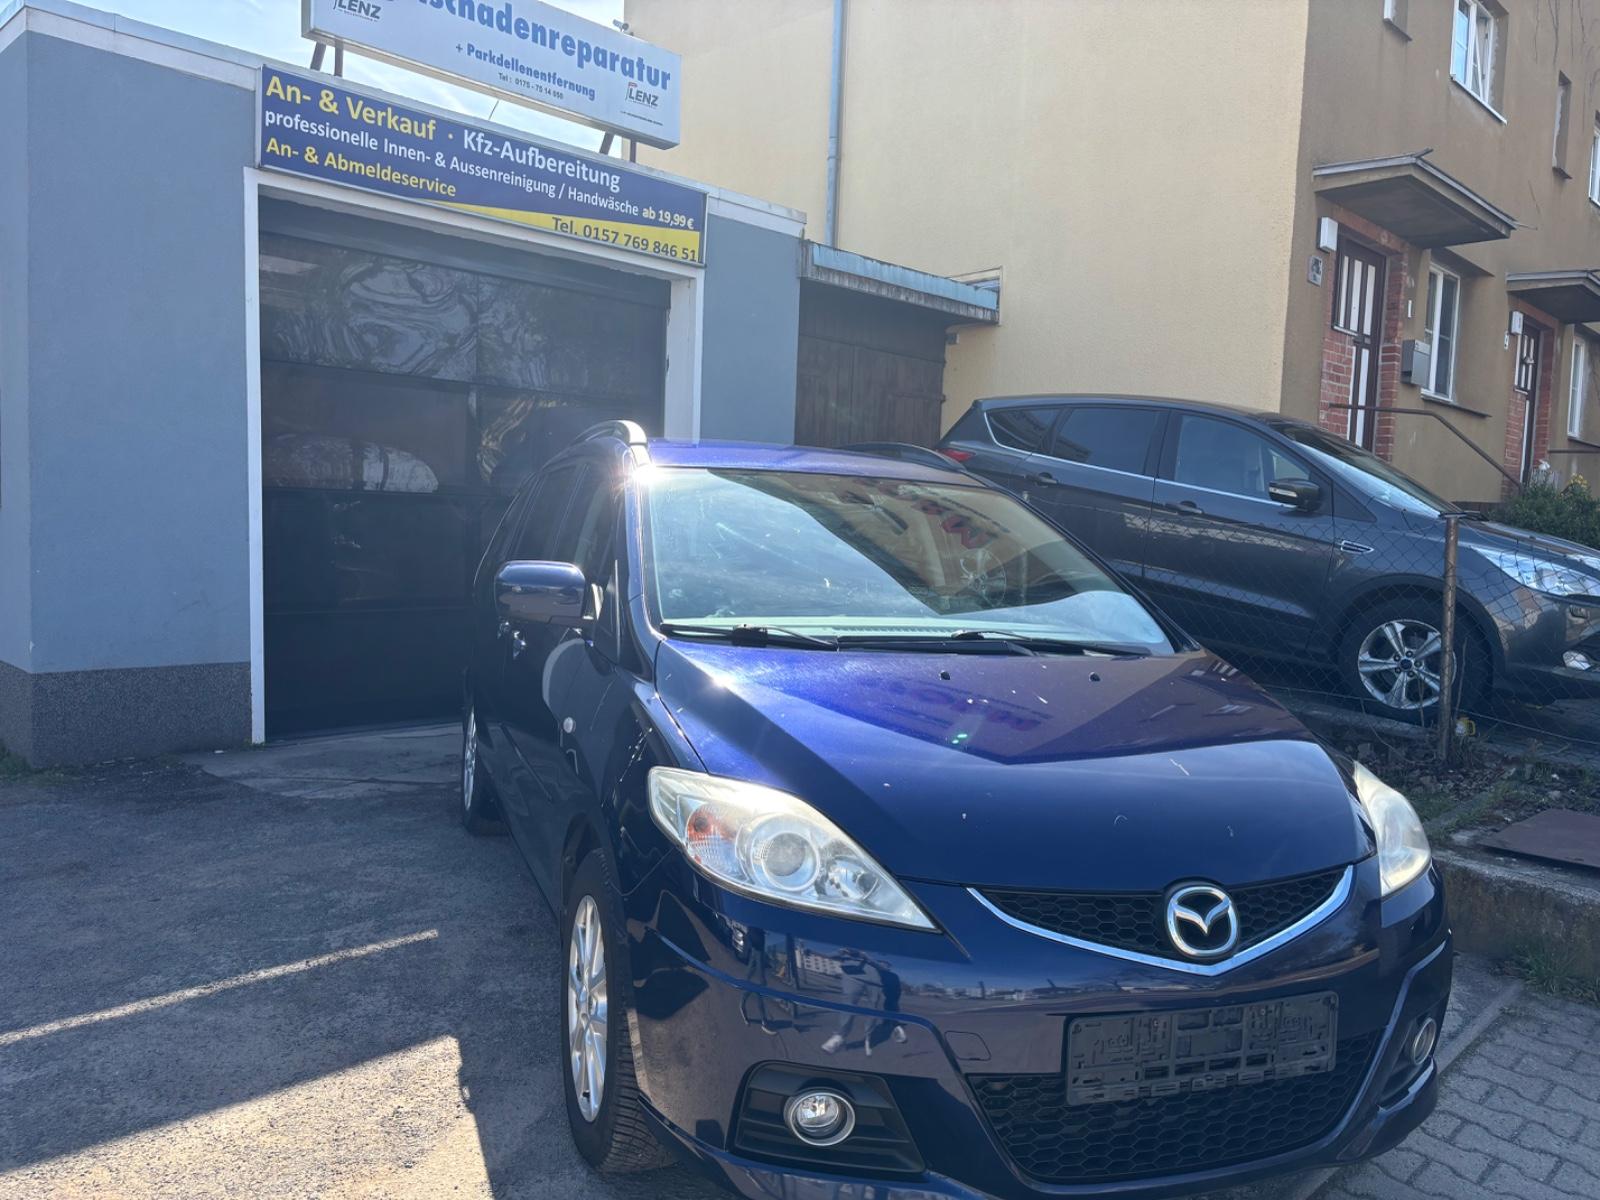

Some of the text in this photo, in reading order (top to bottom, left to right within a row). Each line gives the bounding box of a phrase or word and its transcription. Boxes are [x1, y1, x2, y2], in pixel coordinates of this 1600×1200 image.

[338, 0, 381, 20] LENZ
[466, 43, 596, 101] Parkdellenentfernung
[628, 88, 659, 107] LENZ
[266, 76, 311, 104] An-
[318, 89, 339, 115] &
[346, 96, 436, 140] Verkauf
[463, 129, 621, 193] Kfz-Aufbereitung
[265, 110, 378, 150] professionelle
[384, 138, 431, 162] Innen-
[434, 151, 446, 168] &
[450, 156, 556, 198] Aussenreinigung
[558, 183, 565, 199] /
[568, 187, 639, 216] Handwäsche
[642, 207, 656, 220] ab
[266, 138, 456, 197] An- & Abmeldeservice
[552, 217, 696, 262] Tel. 0157 769 846 51
